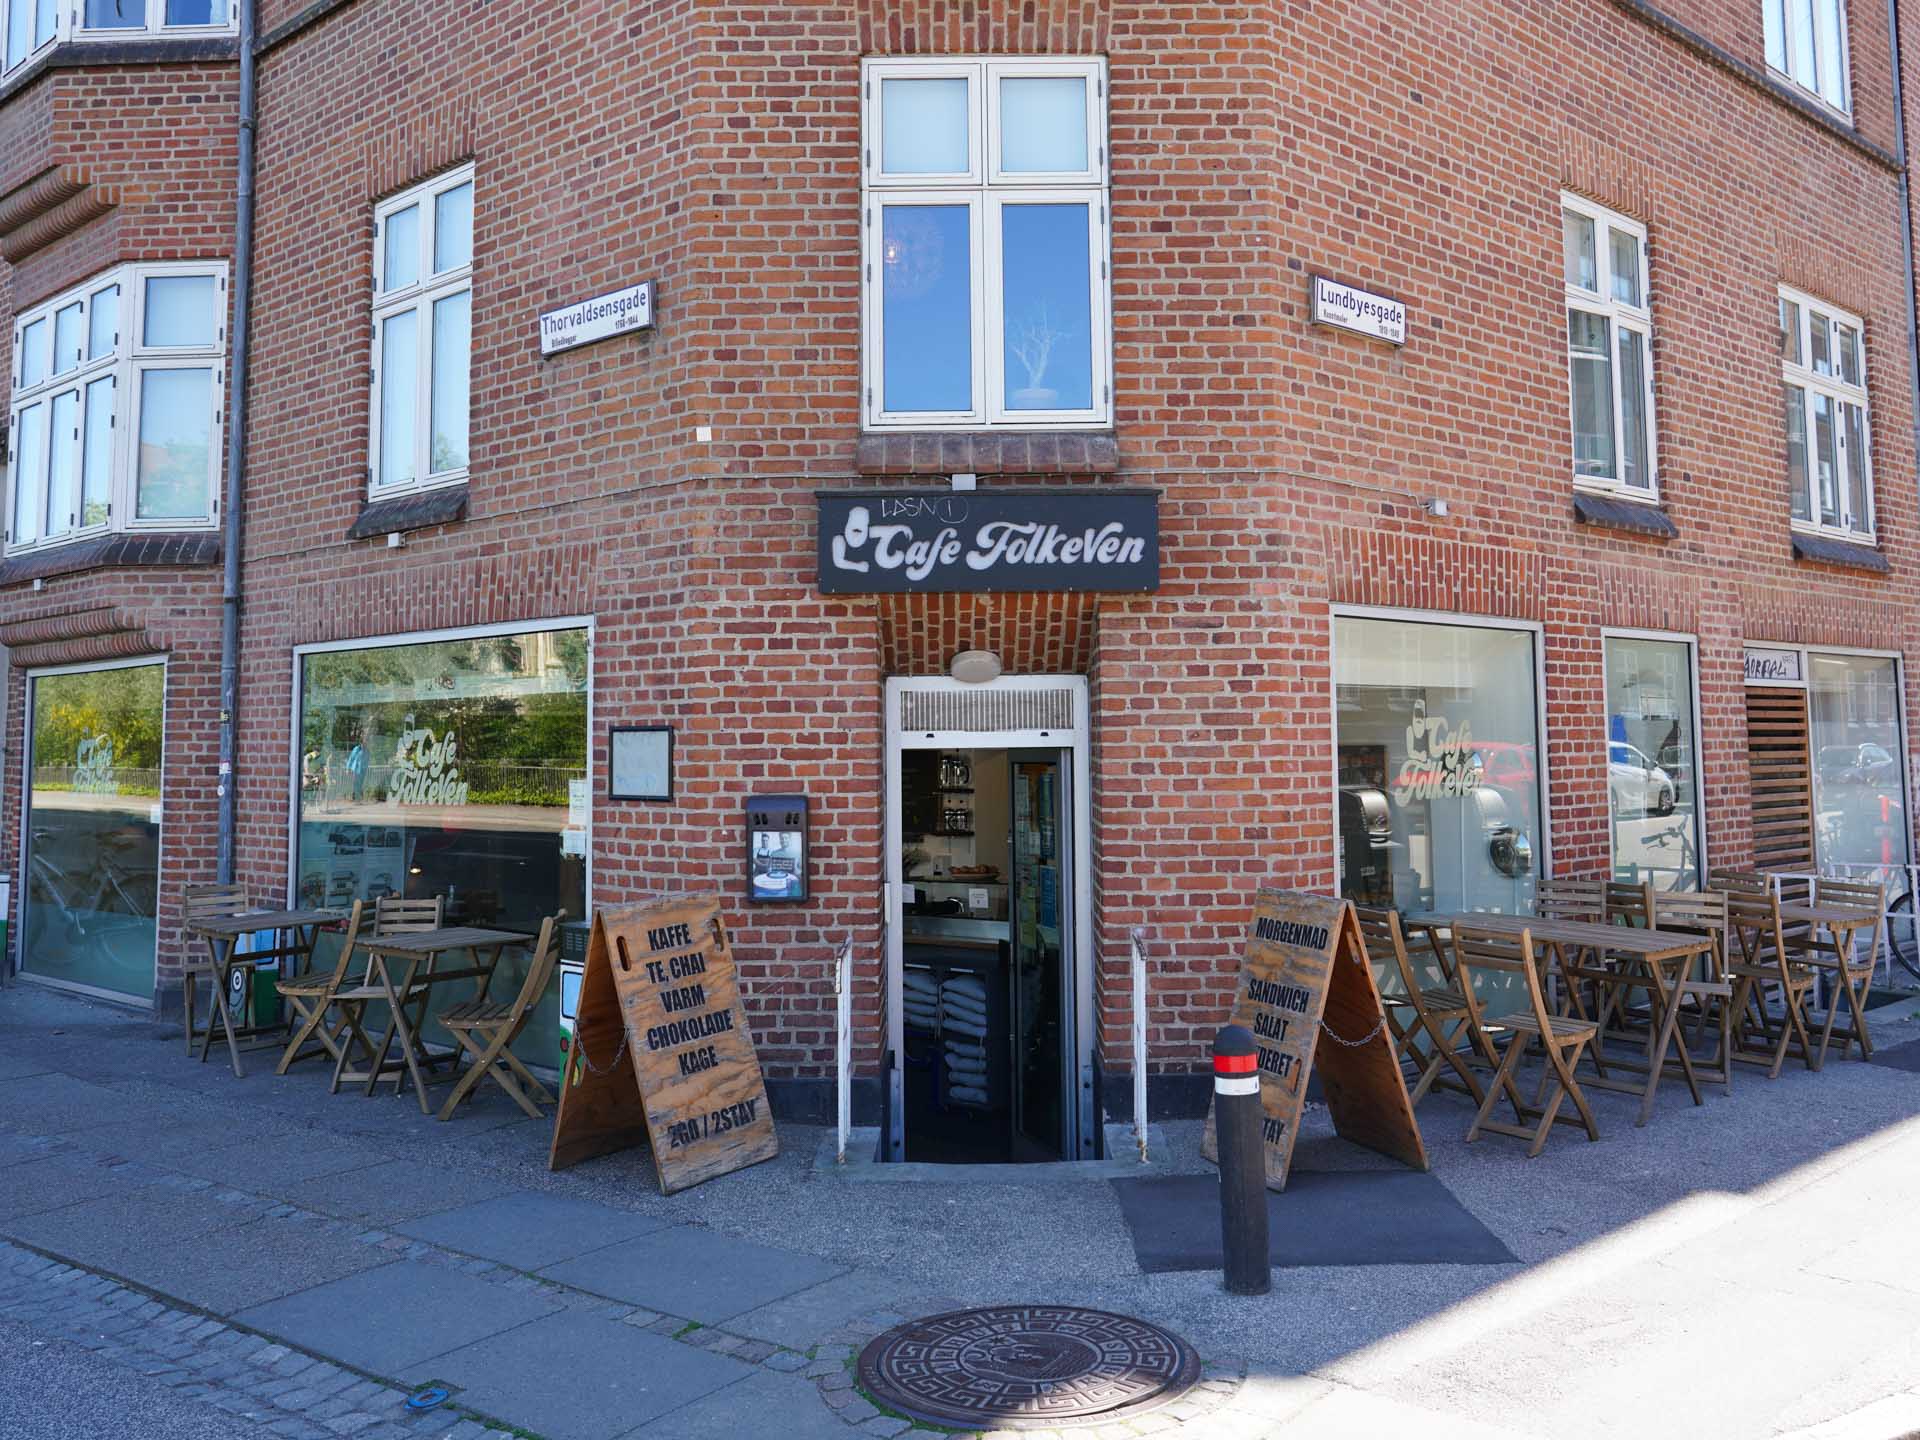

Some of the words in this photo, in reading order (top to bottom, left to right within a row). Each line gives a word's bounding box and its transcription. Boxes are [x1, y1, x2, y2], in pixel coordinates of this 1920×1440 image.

[542, 289, 646, 335] Thorvaldsensgade
[1321, 282, 1402, 324] Lundbyesgade
[868, 523, 962, 581] Cafe
[414, 728, 457, 778] Cafe
[647, 922, 692, 951] KAFFE
[1256, 917, 1329, 951] MORGENMAD
[645, 962, 670, 985] TE,
[672, 951, 706, 979] CHAI
[660, 984, 706, 1013] VARM
[1247, 978, 1310, 1013] SANDWICH
[646, 1009, 734, 1051] CHOKOLADE
[1253, 1011, 1290, 1041] SALAT
[678, 1045, 719, 1077] KAGE
[1257, 1045, 1294, 1078] DERET
[667, 1121, 702, 1149] 2GO
[711, 1099, 758, 1136] 2STAY
[1263, 1117, 1285, 1146] TAY
